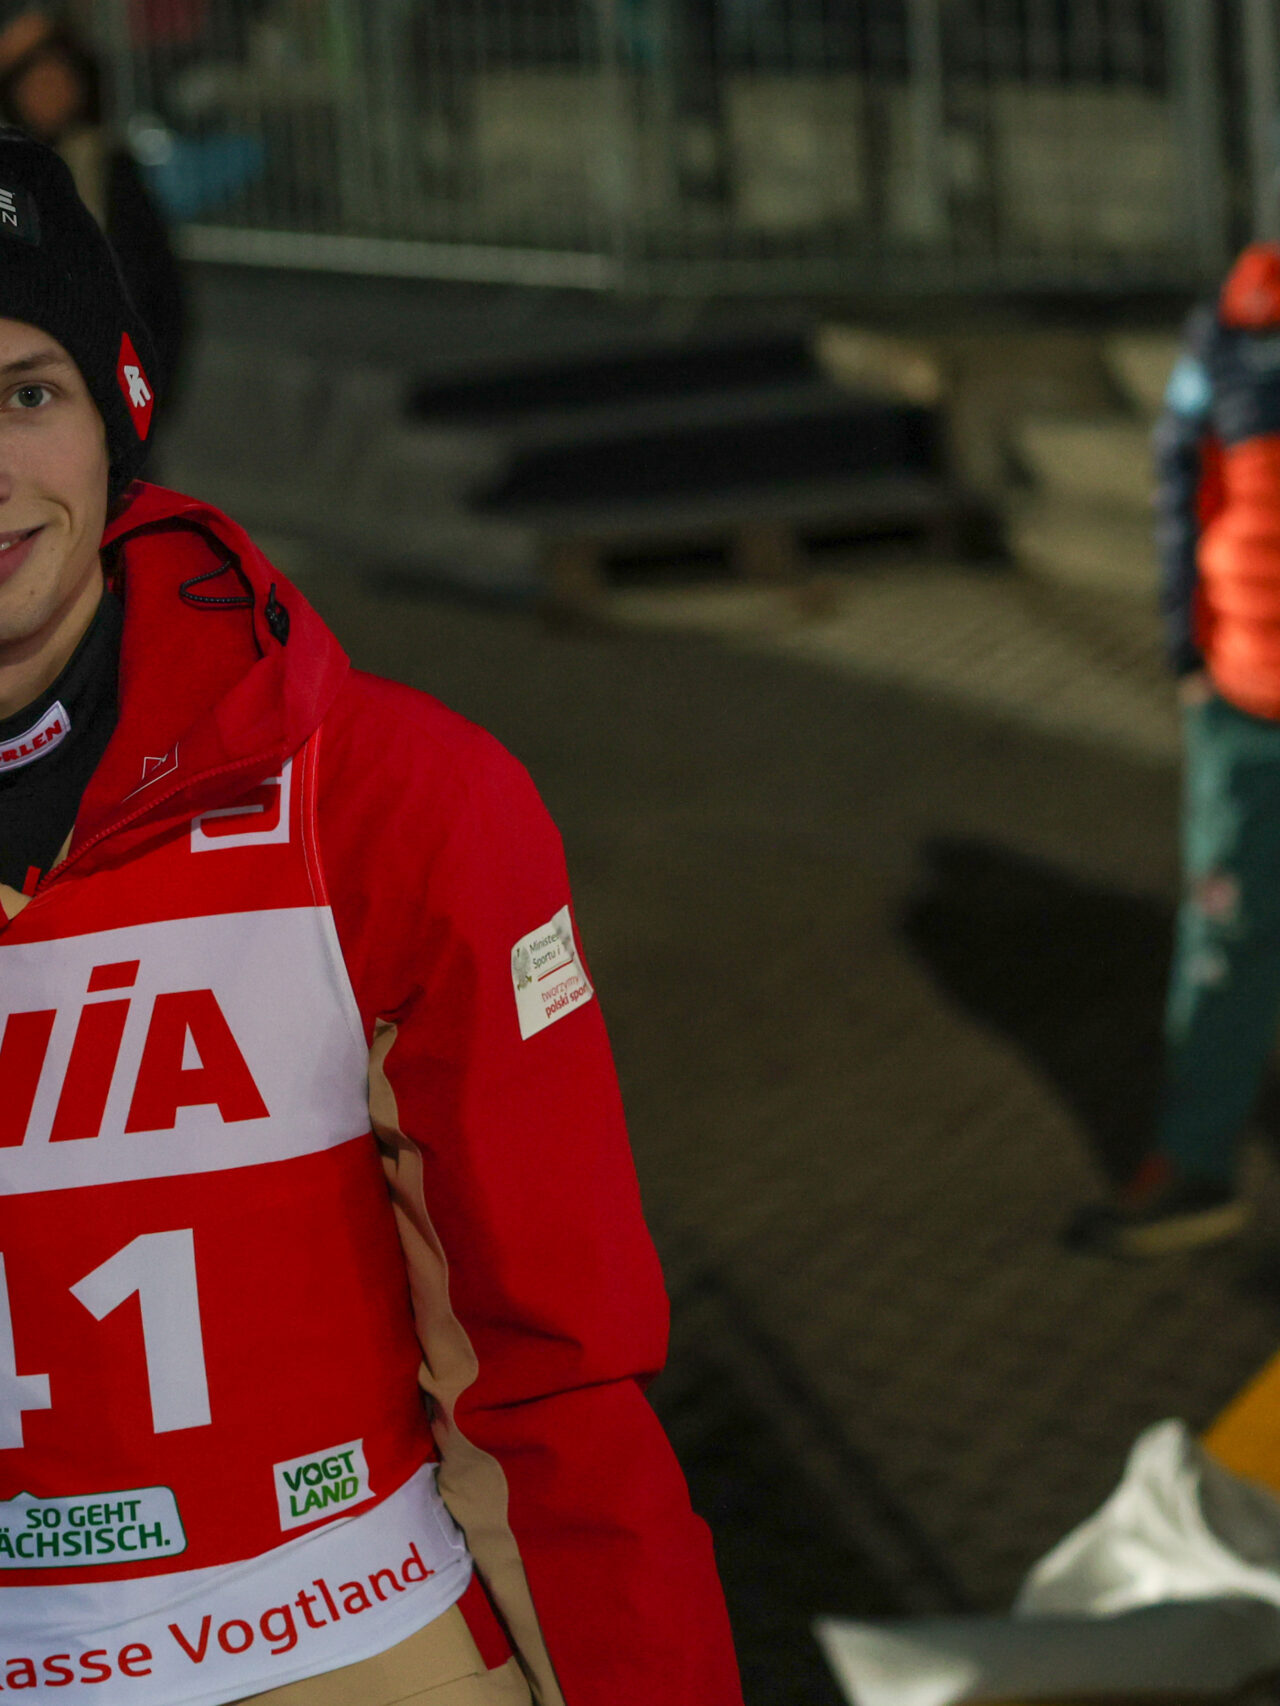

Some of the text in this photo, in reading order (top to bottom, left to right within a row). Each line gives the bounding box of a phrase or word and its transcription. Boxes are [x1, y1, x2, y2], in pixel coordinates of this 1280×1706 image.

[532, 949, 556, 969] Sportu
[545, 992, 569, 1019] polski
[282, 1450, 355, 1492] VOGT
[26, 1499, 141, 1530] SO GEHT
[289, 1475, 360, 1518] LAND
[168, 1541, 435, 1655] Vogtland
